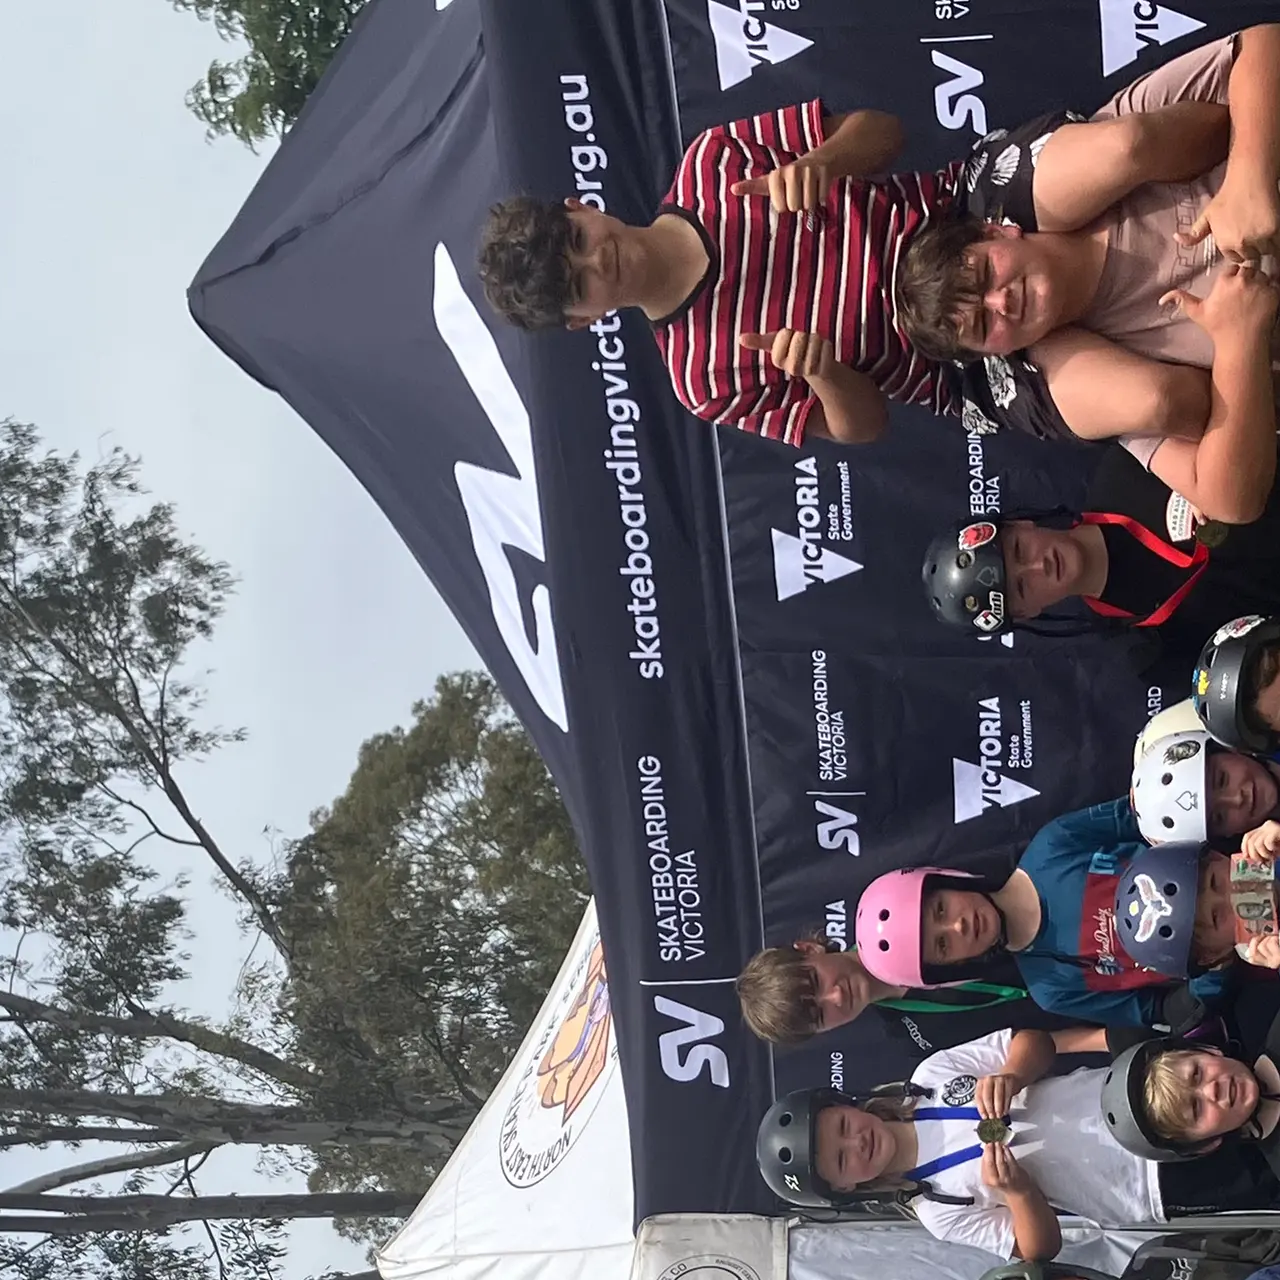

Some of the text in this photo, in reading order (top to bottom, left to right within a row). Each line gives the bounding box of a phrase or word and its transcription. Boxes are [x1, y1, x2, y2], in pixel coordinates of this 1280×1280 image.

[930, 49, 988, 137] SV
[793, 456, 826, 590] VICTORIA
[826, 503, 841, 541] State
[836, 460, 855, 541] Government
[811, 649, 833, 781] SKATEBOARDING
[829, 710, 849, 781] VICTORIA
[977, 695, 1004, 811] VICTORIA
[1007, 734, 1021, 769] State
[1017, 699, 1034, 769] Government
[637, 754, 682, 962] SKATEBOARDING
[813, 799, 860, 857] SV
[673, 849, 706, 962] VICTORIA
[653, 995, 731, 1088] SV
[505, 1142, 532, 1181] EAST
[526, 1124, 573, 1179] NORTH
[669, 1262, 688, 1276] CO
